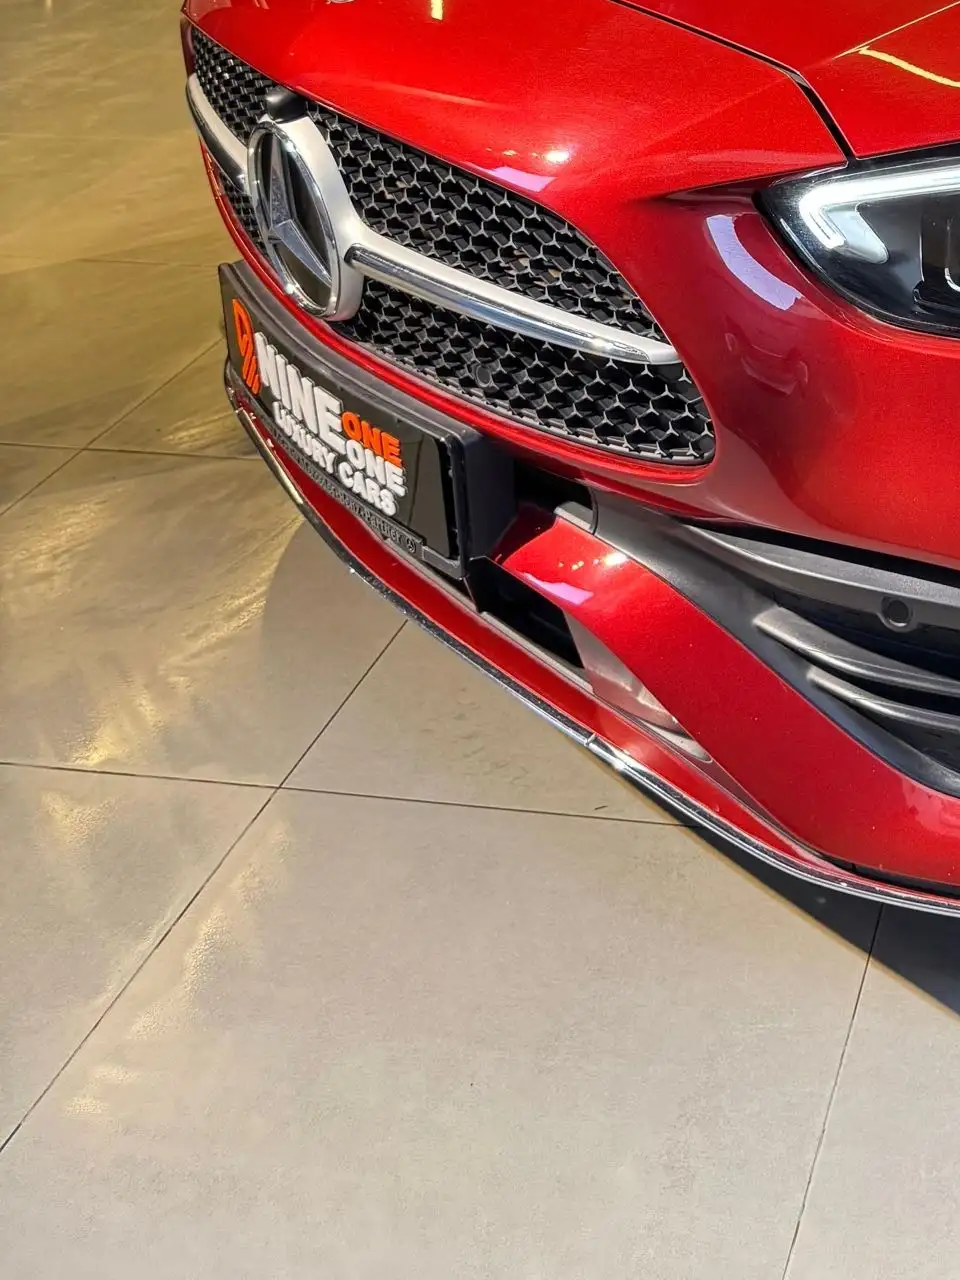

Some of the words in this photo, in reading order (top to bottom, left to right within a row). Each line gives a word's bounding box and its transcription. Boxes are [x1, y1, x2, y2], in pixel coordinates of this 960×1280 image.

[255, 332, 347, 456] NINE
[341, 411, 403, 468] ONE
[337, 461, 397, 517] CARS
[345, 439, 406, 497] ONE
